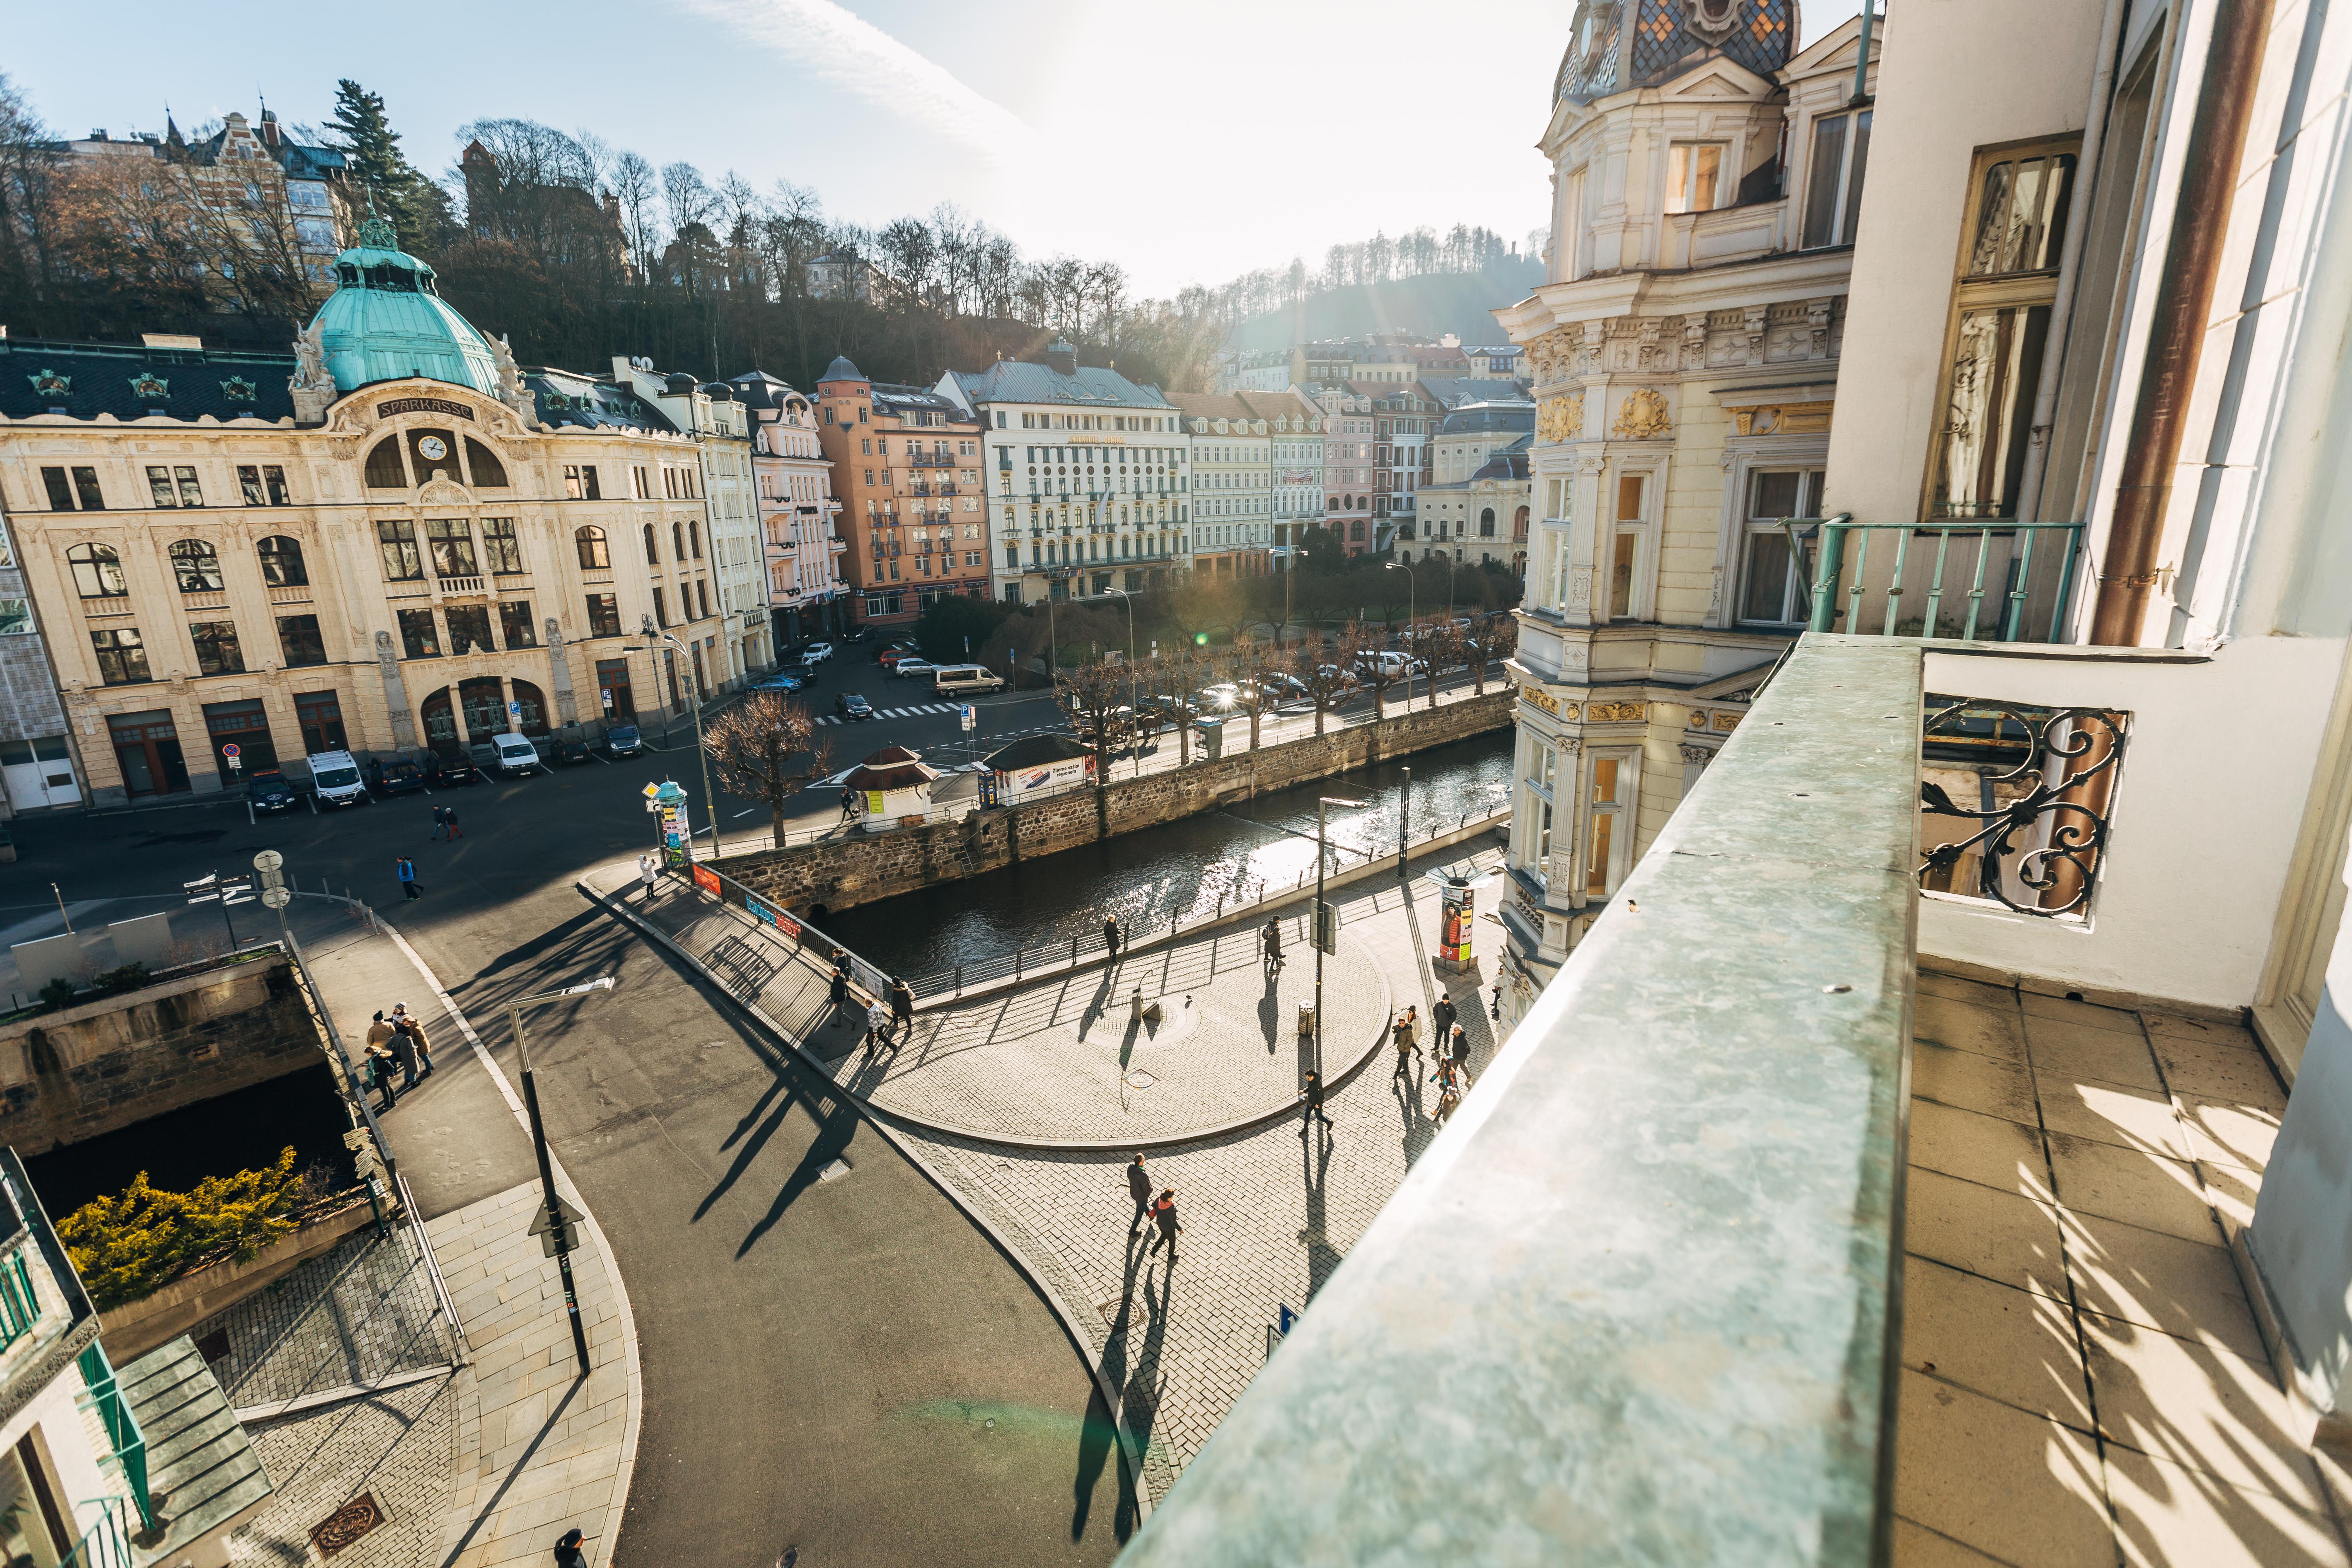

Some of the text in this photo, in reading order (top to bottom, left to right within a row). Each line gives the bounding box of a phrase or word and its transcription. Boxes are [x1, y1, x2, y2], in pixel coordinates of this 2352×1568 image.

[382, 399, 471, 418] SPARKASSE
[1018, 768, 1037, 778] karlovarský
[1031, 771, 1043, 780] DNES
[746, 894, 776, 929] Karlovy
